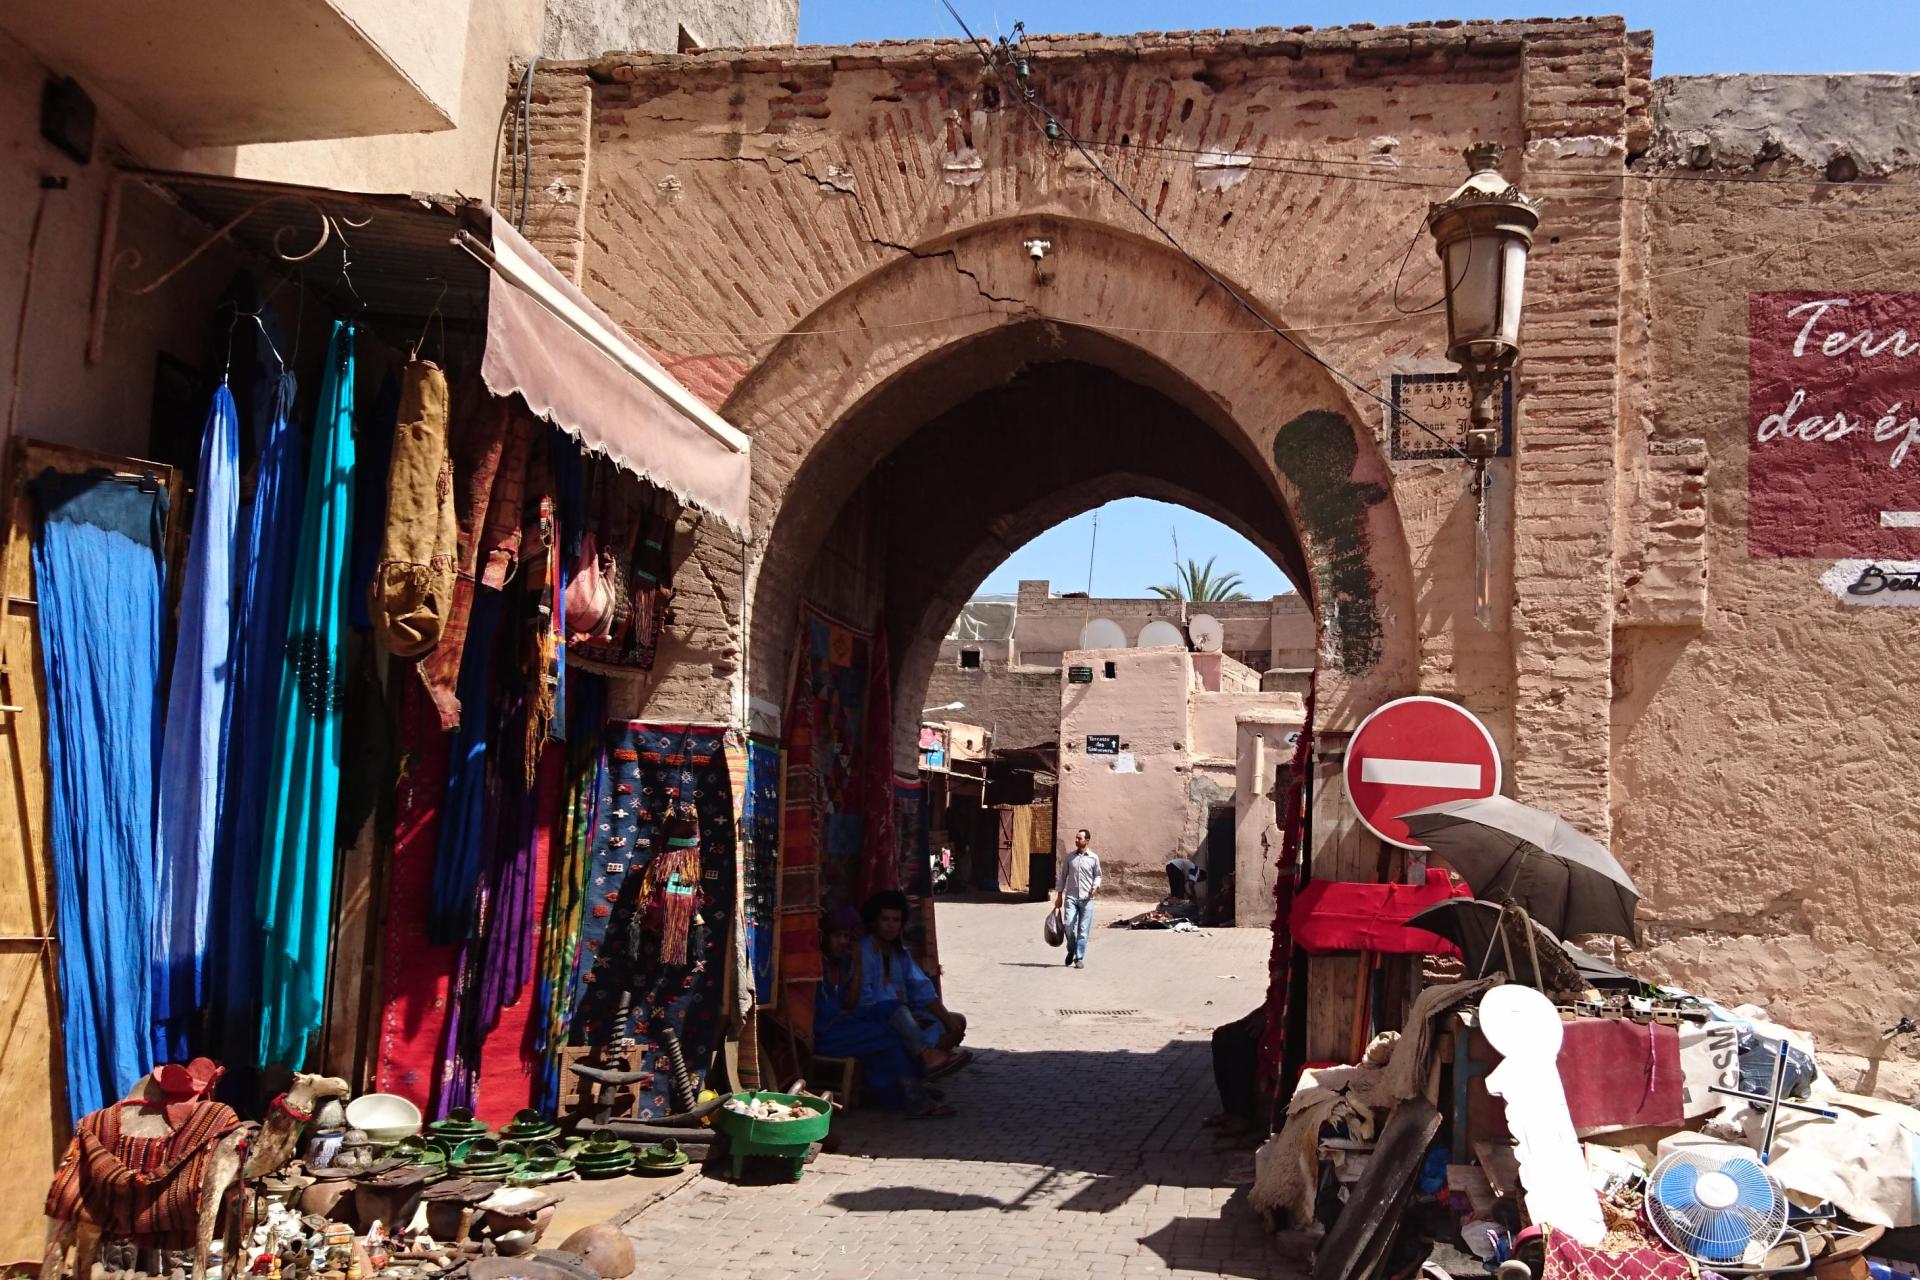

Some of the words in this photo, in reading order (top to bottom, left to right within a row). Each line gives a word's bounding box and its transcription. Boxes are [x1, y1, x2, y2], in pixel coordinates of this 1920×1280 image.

[1787, 298, 1920, 358] Terr
[1757, 388, 1860, 442] des
[1874, 402, 1920, 469] ép
